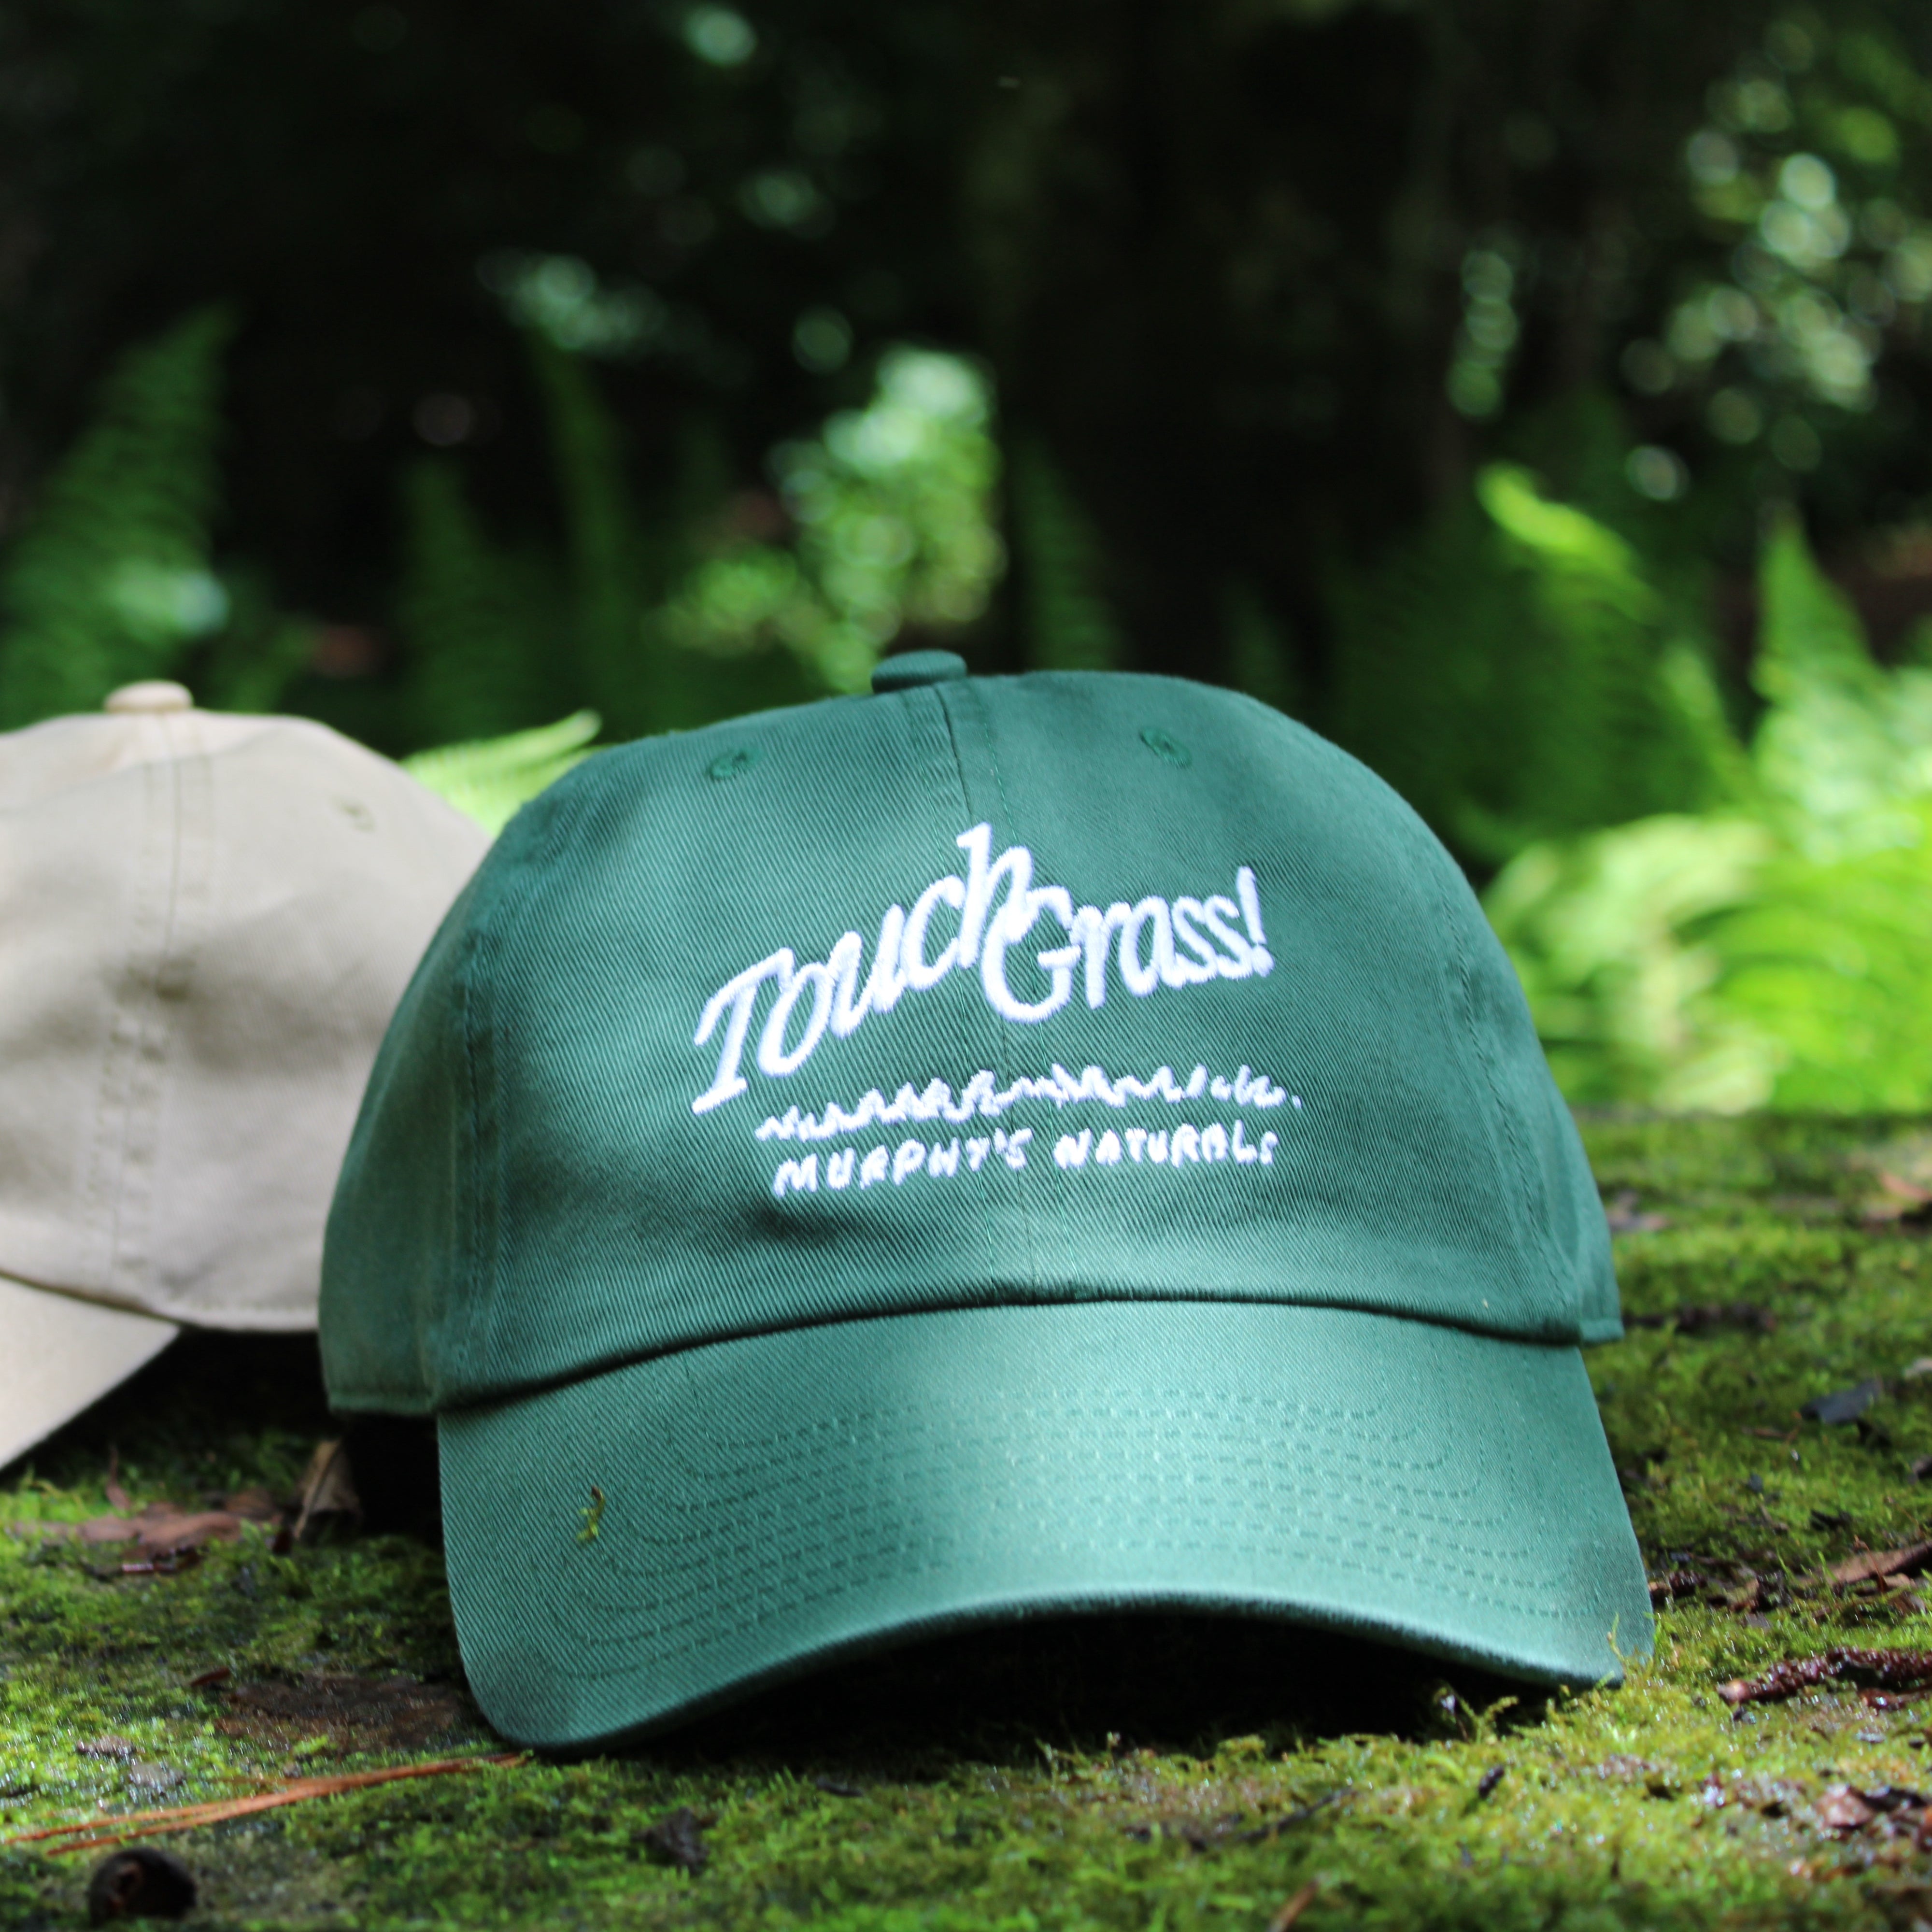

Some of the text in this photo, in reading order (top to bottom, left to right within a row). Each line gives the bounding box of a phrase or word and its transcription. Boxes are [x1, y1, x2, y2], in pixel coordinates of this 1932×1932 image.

[692, 822, 1274, 1115] Touch Grass!
[773, 1119, 1279, 1197] MURPHY'S NATURALS
